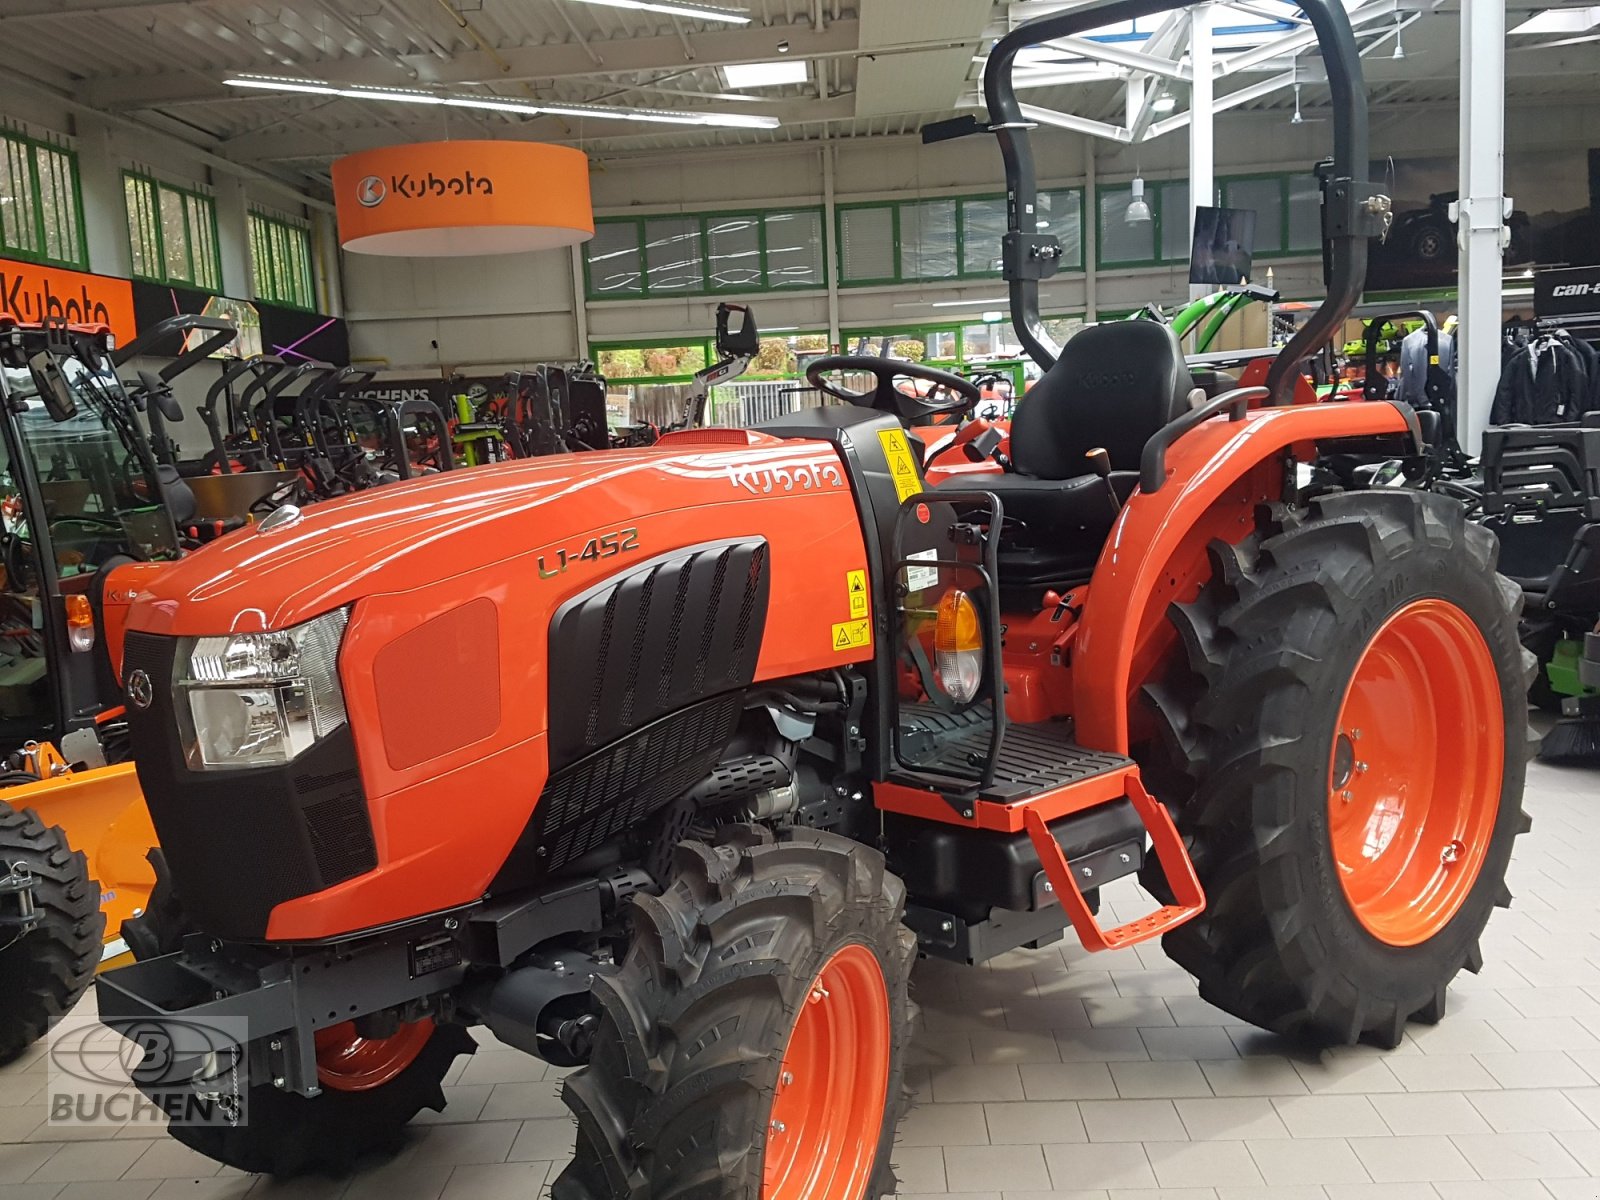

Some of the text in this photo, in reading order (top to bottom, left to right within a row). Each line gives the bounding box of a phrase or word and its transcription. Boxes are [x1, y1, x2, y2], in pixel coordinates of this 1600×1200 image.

[391, 170, 494, 199] Kubota
[0, 272, 110, 327] Kubota
[725, 463, 843, 495] Kubota
[537, 526, 640, 580] L1-452
